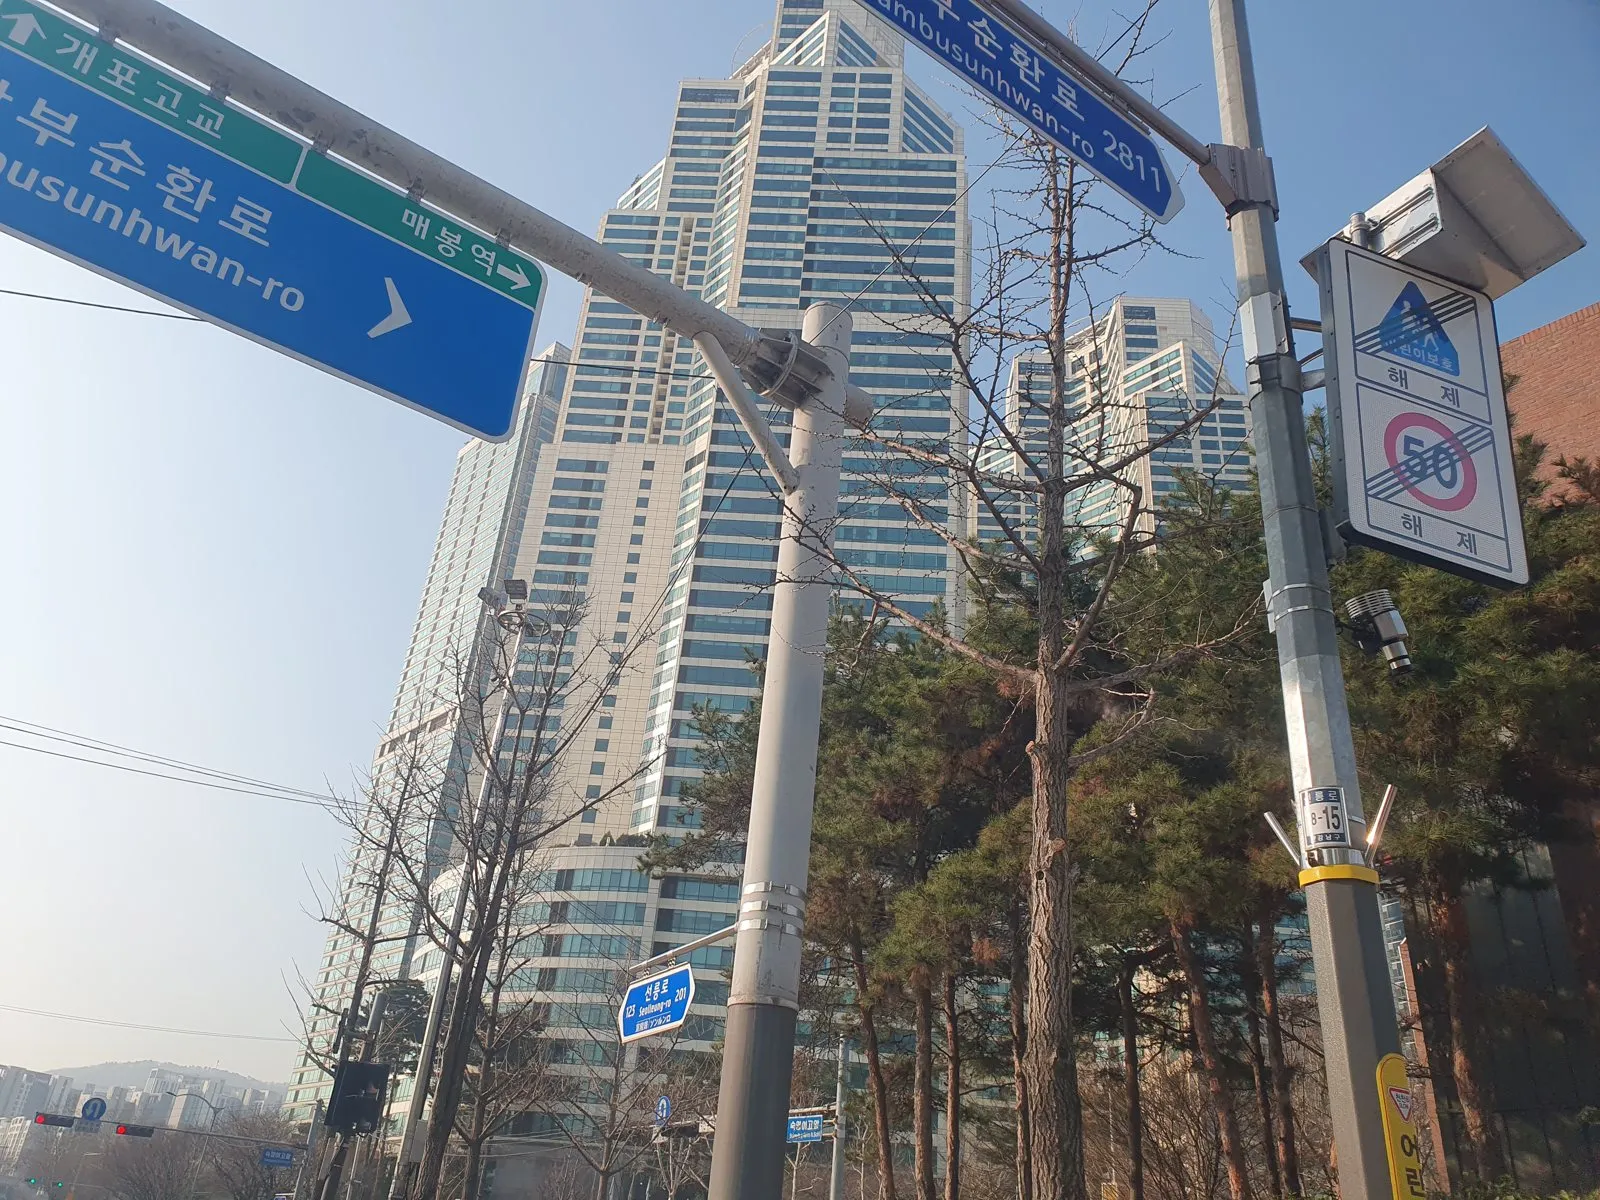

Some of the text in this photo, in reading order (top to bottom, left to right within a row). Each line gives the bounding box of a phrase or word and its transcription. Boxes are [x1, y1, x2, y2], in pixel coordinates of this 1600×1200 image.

[55, 32, 226, 139] 개포고교
[0, 79, 273, 247] 부순환로
[1103, 129, 1161, 193] 2811
[0, 152, 305, 312] usunhwan-ro
[401, 208, 498, 276] 매봉역
[1388, 367, 1460, 408] 해 제
[1403, 434, 1458, 490] 50
[1401, 512, 1478, 555] 해 제
[1311, 805, 1341, 830] 8-15
[626, 1004, 636, 1018] 123
[645, 979, 687, 1002] 선릉로 201
